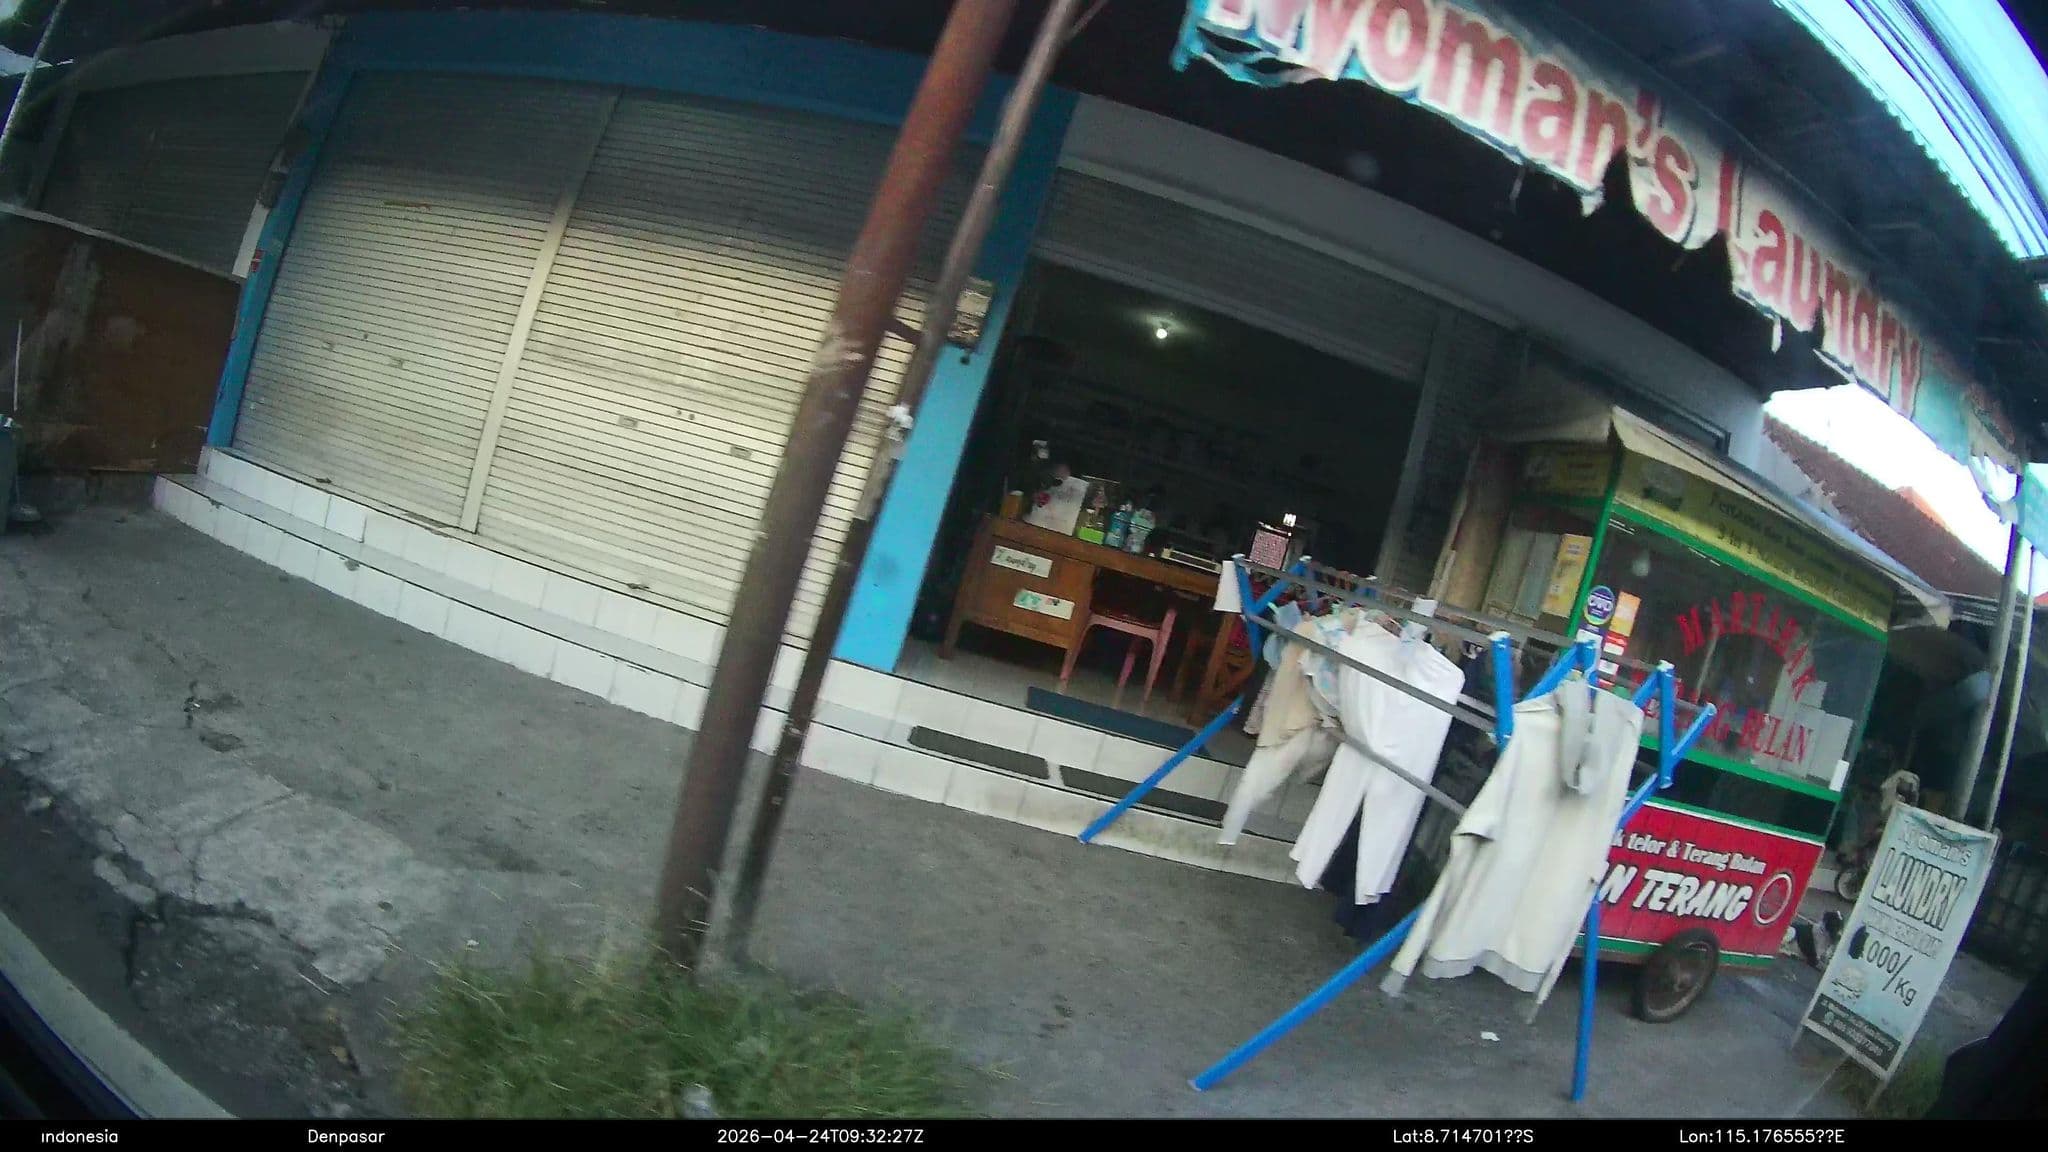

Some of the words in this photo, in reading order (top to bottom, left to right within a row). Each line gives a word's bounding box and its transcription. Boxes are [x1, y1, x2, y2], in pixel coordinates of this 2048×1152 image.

[1627, 833, 1667, 855] telor
[1667, 840, 1681, 858] &
[1668, 842, 1730, 872] Terang
[1632, 869, 1753, 922] TERANG
[1871, 847, 1968, 932] LAUNDRY
